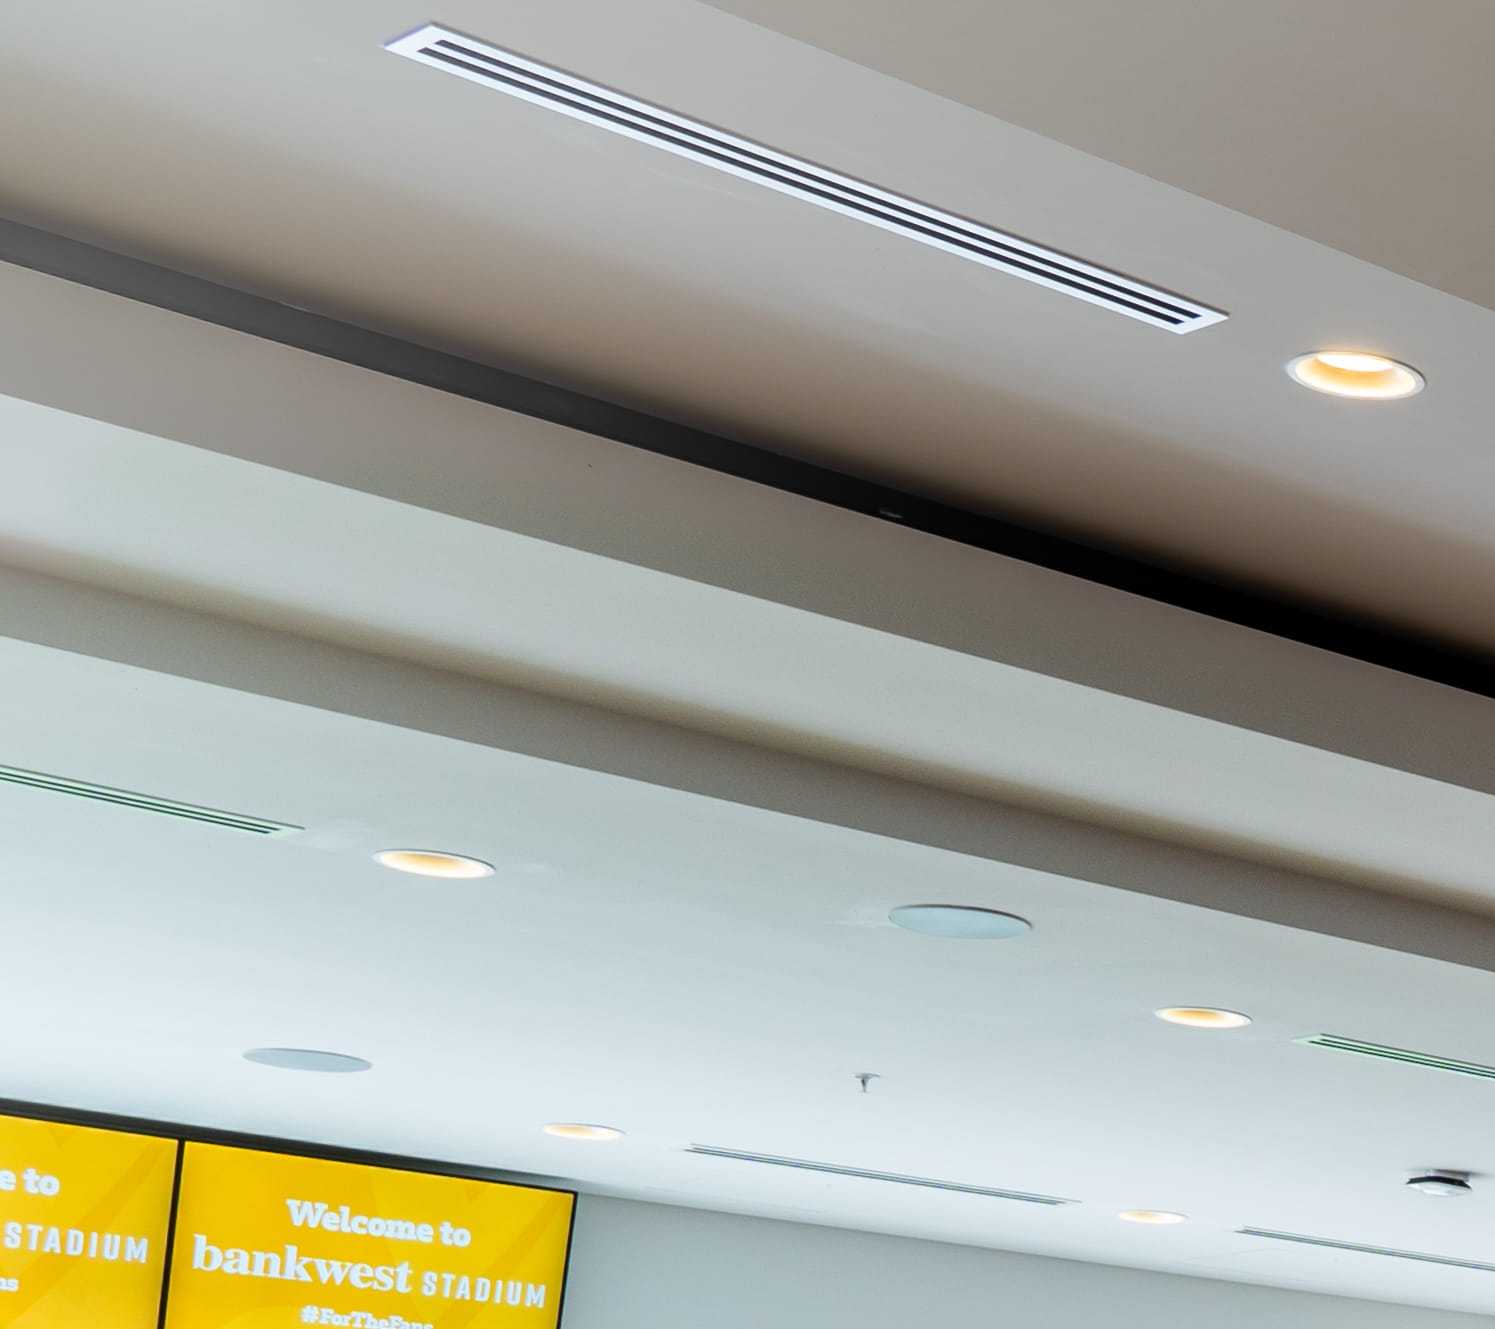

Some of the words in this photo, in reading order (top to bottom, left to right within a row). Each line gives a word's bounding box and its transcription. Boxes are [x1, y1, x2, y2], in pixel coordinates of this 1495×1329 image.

[22, 1167, 60, 1196] to
[4, 1221, 149, 1264] STADIUM
[286, 1199, 434, 1243] Welcome
[439, 1221, 471, 1247] to
[192, 1233, 412, 1293] bankwest
[421, 1271, 546, 1308] STADIUM
